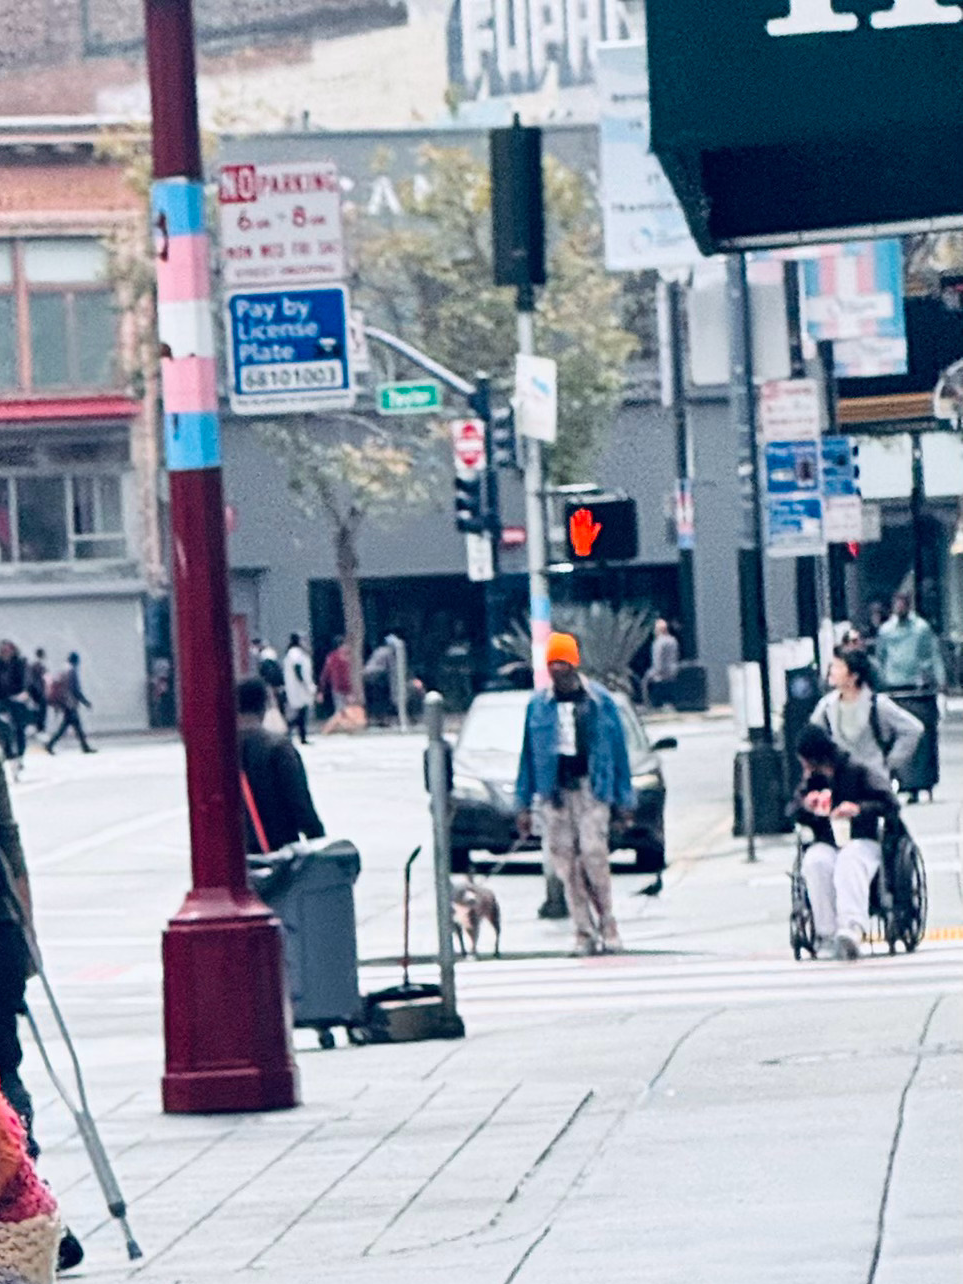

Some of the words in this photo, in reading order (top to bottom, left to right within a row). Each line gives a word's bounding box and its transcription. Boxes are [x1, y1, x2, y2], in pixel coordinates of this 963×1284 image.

[221, 167, 254, 199] NO
[256, 172, 338, 195] PARKING
[236, 299, 276, 321] Pay
[282, 296, 312, 321] by
[237, 321, 320, 341] License
[238, 342, 296, 363] Plate
